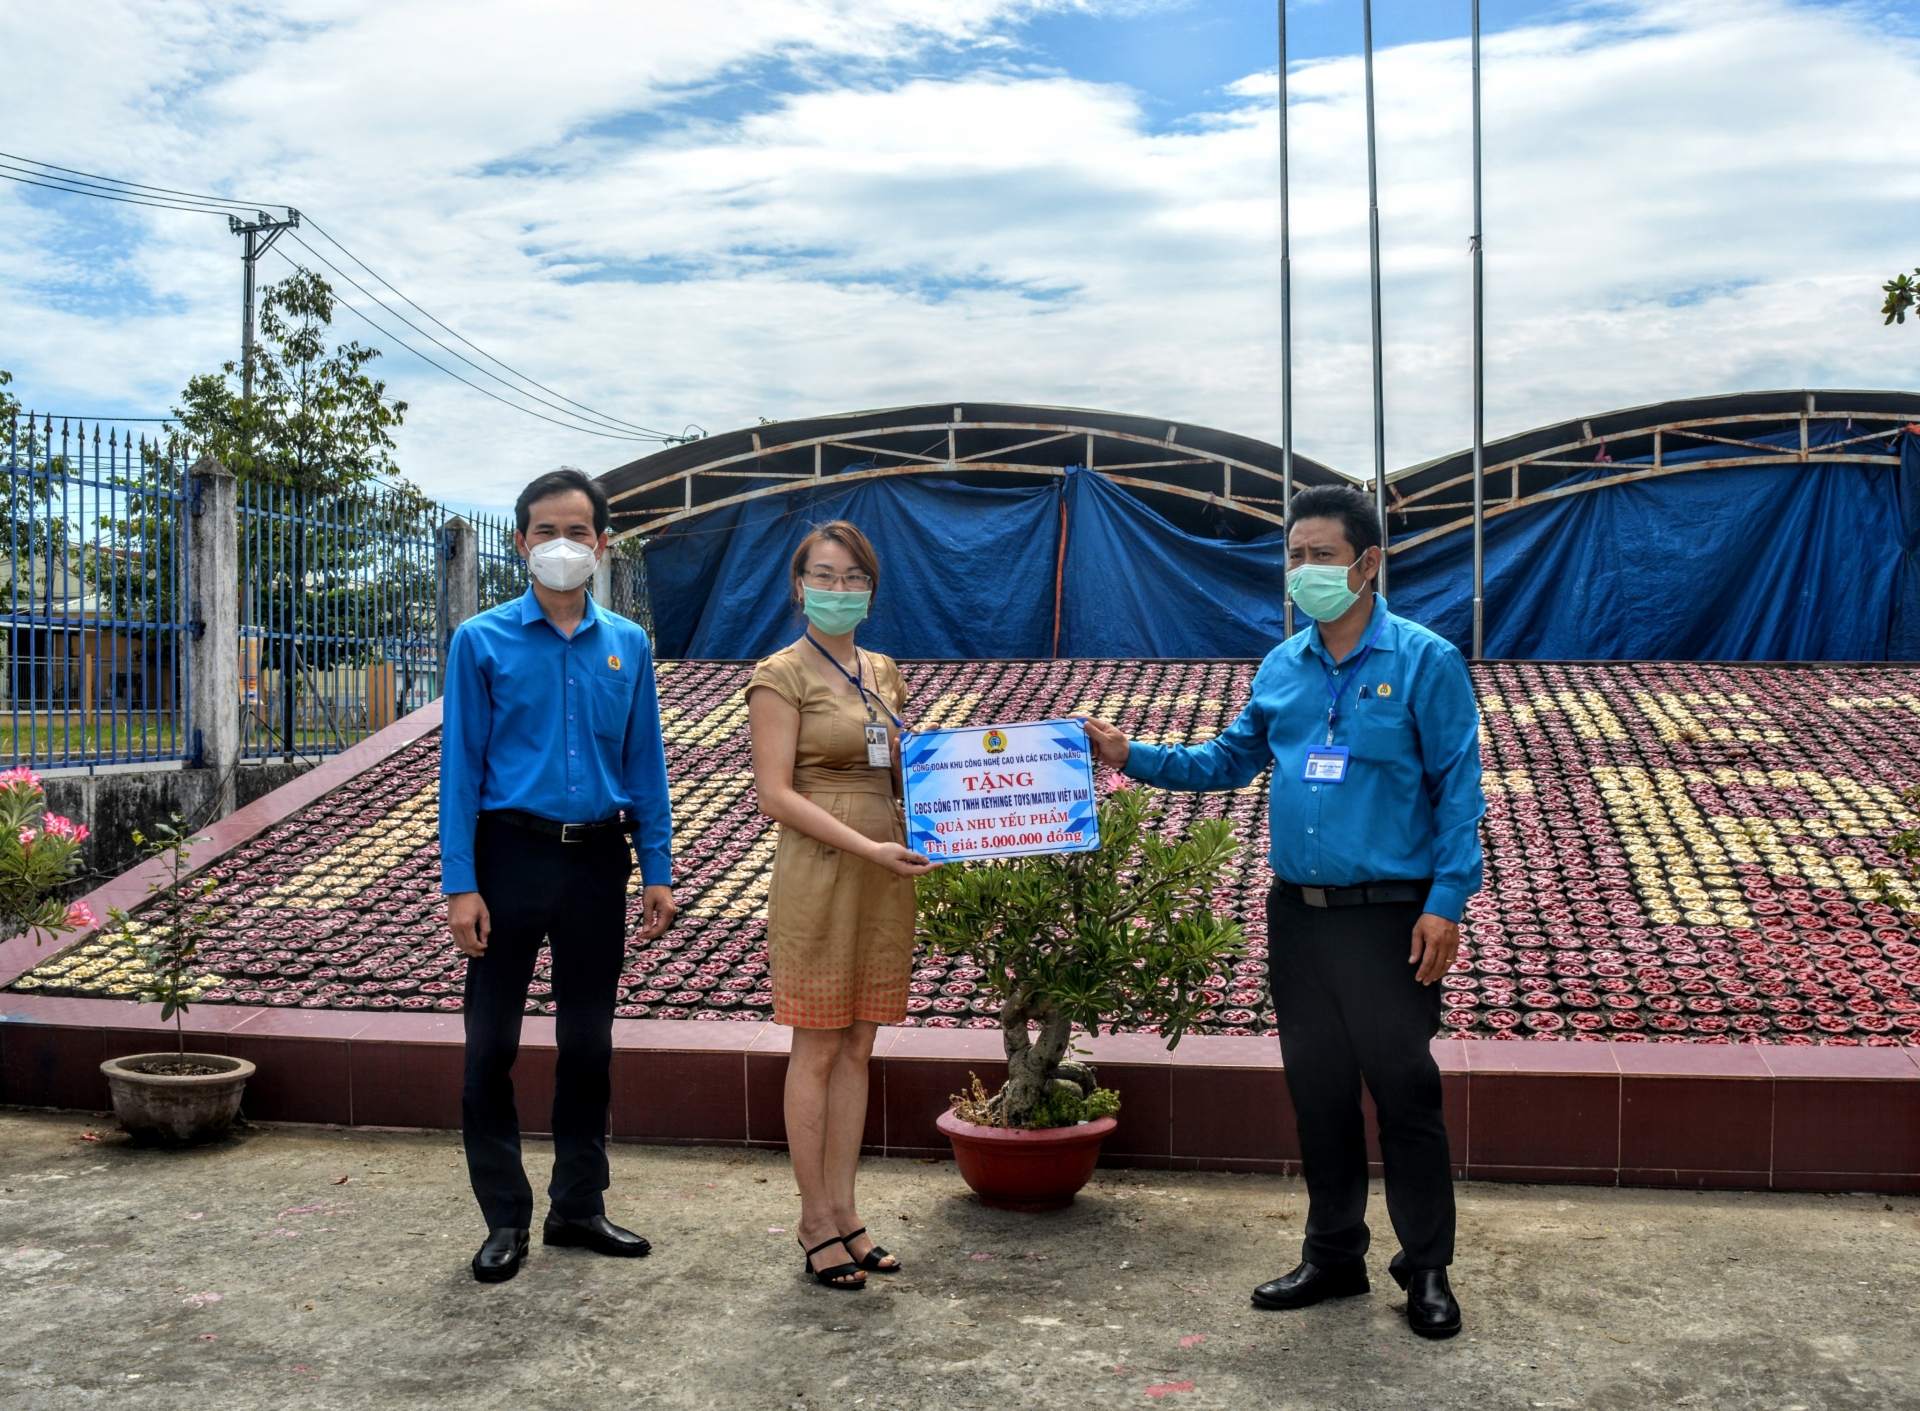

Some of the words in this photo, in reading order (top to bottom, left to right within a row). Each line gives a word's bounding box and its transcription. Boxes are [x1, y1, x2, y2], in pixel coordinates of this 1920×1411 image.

[912, 762, 930, 772] CÔNG
[931, 762, 949, 771] ĐOÀN
[950, 760, 963, 769] KHU
[964, 758, 982, 768] CÔNG
[983, 756, 1000, 767] NGHỆ
[1001, 755, 1014, 765] CAO
[1016, 754, 1024, 764] VÀ
[1026, 752, 1038, 763] CÁC
[1039, 753, 1052, 762] KCN
[1053, 751, 1062, 760] ĐÀ
[962, 771, 1034, 794] TẶNG
[914, 802, 932, 815] CĐCS
[933, 798, 951, 813] CÔNG
[952, 799, 961, 812] TY
[962, 798, 980, 811] TNHH
[981, 794, 1012, 810] KEYHINGE
[1014, 791, 1056, 807] TOYS/MATRIX
[1057, 788, 1072, 805] VIỆT
[1073, 788, 1088, 801] NAM
[935, 818, 965, 835] QUÀ
[966, 818, 996, 831] NHU
[999, 812, 1026, 828] YẾU
[1030, 806, 1069, 825] PHẨM
[924, 840, 948, 854] Trị
[952, 836, 978, 854] giá:
[981, 832, 1043, 849] 5.000.000
[1046, 828, 1083, 844] đồng
